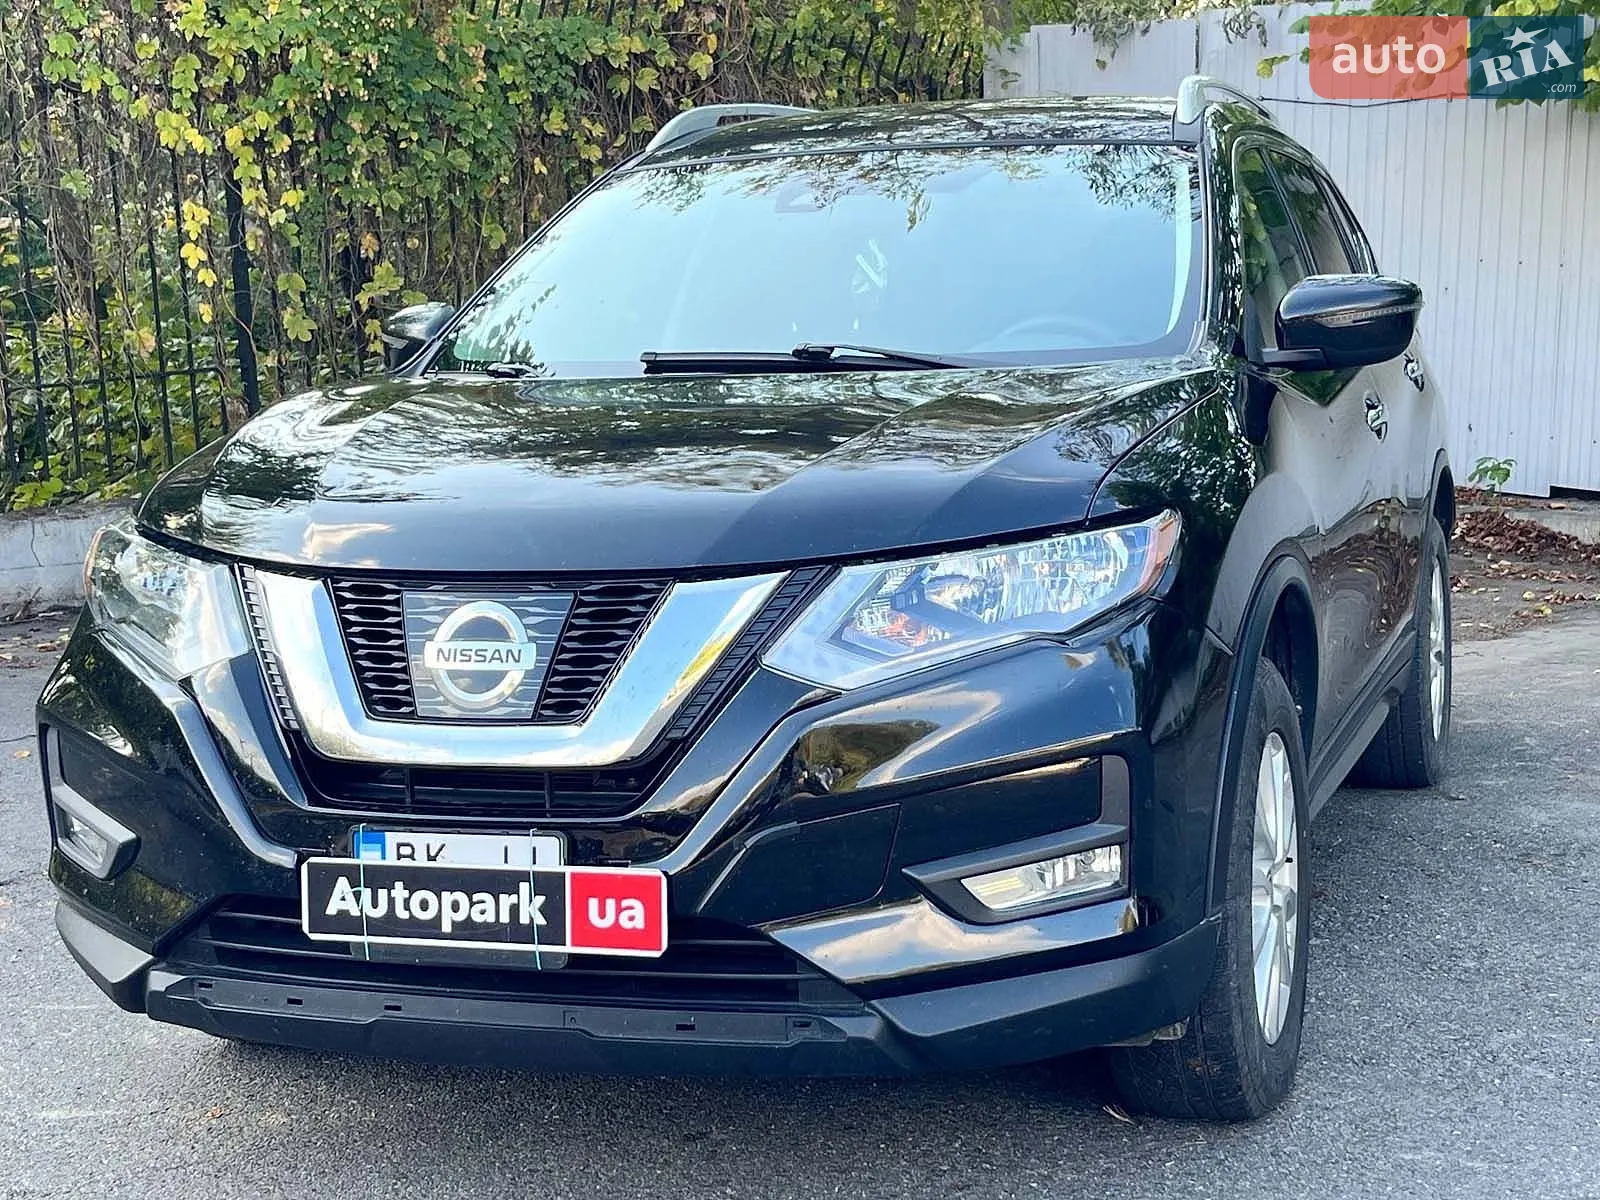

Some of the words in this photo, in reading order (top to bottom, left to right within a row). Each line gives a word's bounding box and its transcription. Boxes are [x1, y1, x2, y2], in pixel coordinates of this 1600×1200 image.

[436, 647, 522, 664] NISSAN
[325, 876, 547, 933] Autopark
[588, 896, 646, 930] ua
